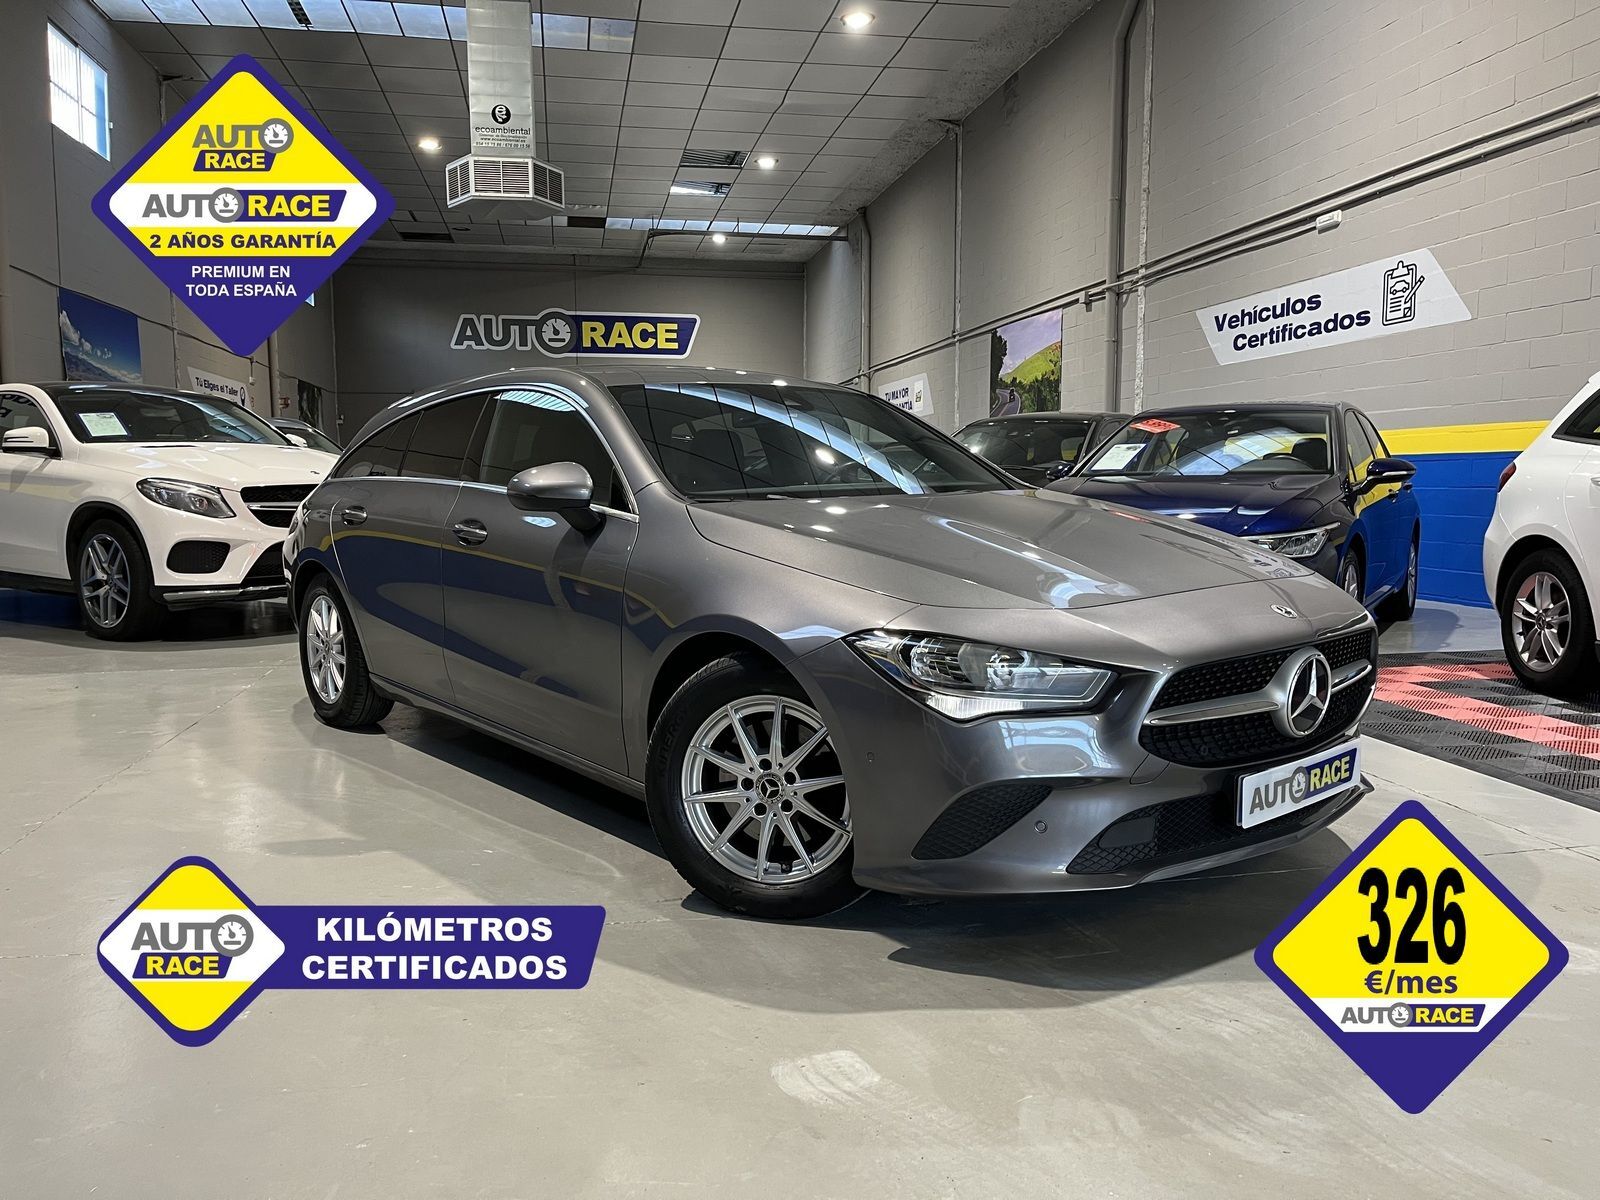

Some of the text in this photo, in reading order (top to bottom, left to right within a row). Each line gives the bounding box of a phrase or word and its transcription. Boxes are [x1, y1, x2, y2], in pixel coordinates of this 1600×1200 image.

[475, 126, 531, 135] ecoambiental
[1213, 293, 1322, 332] Vehículos
[581, 321, 679, 349] RACE
[1232, 309, 1371, 351] Certificados
[195, 377, 239, 396] Tú Eliges el Taller
[885, 387, 909, 402] TU MAYOR
[1309, 756, 1350, 792] RACE
